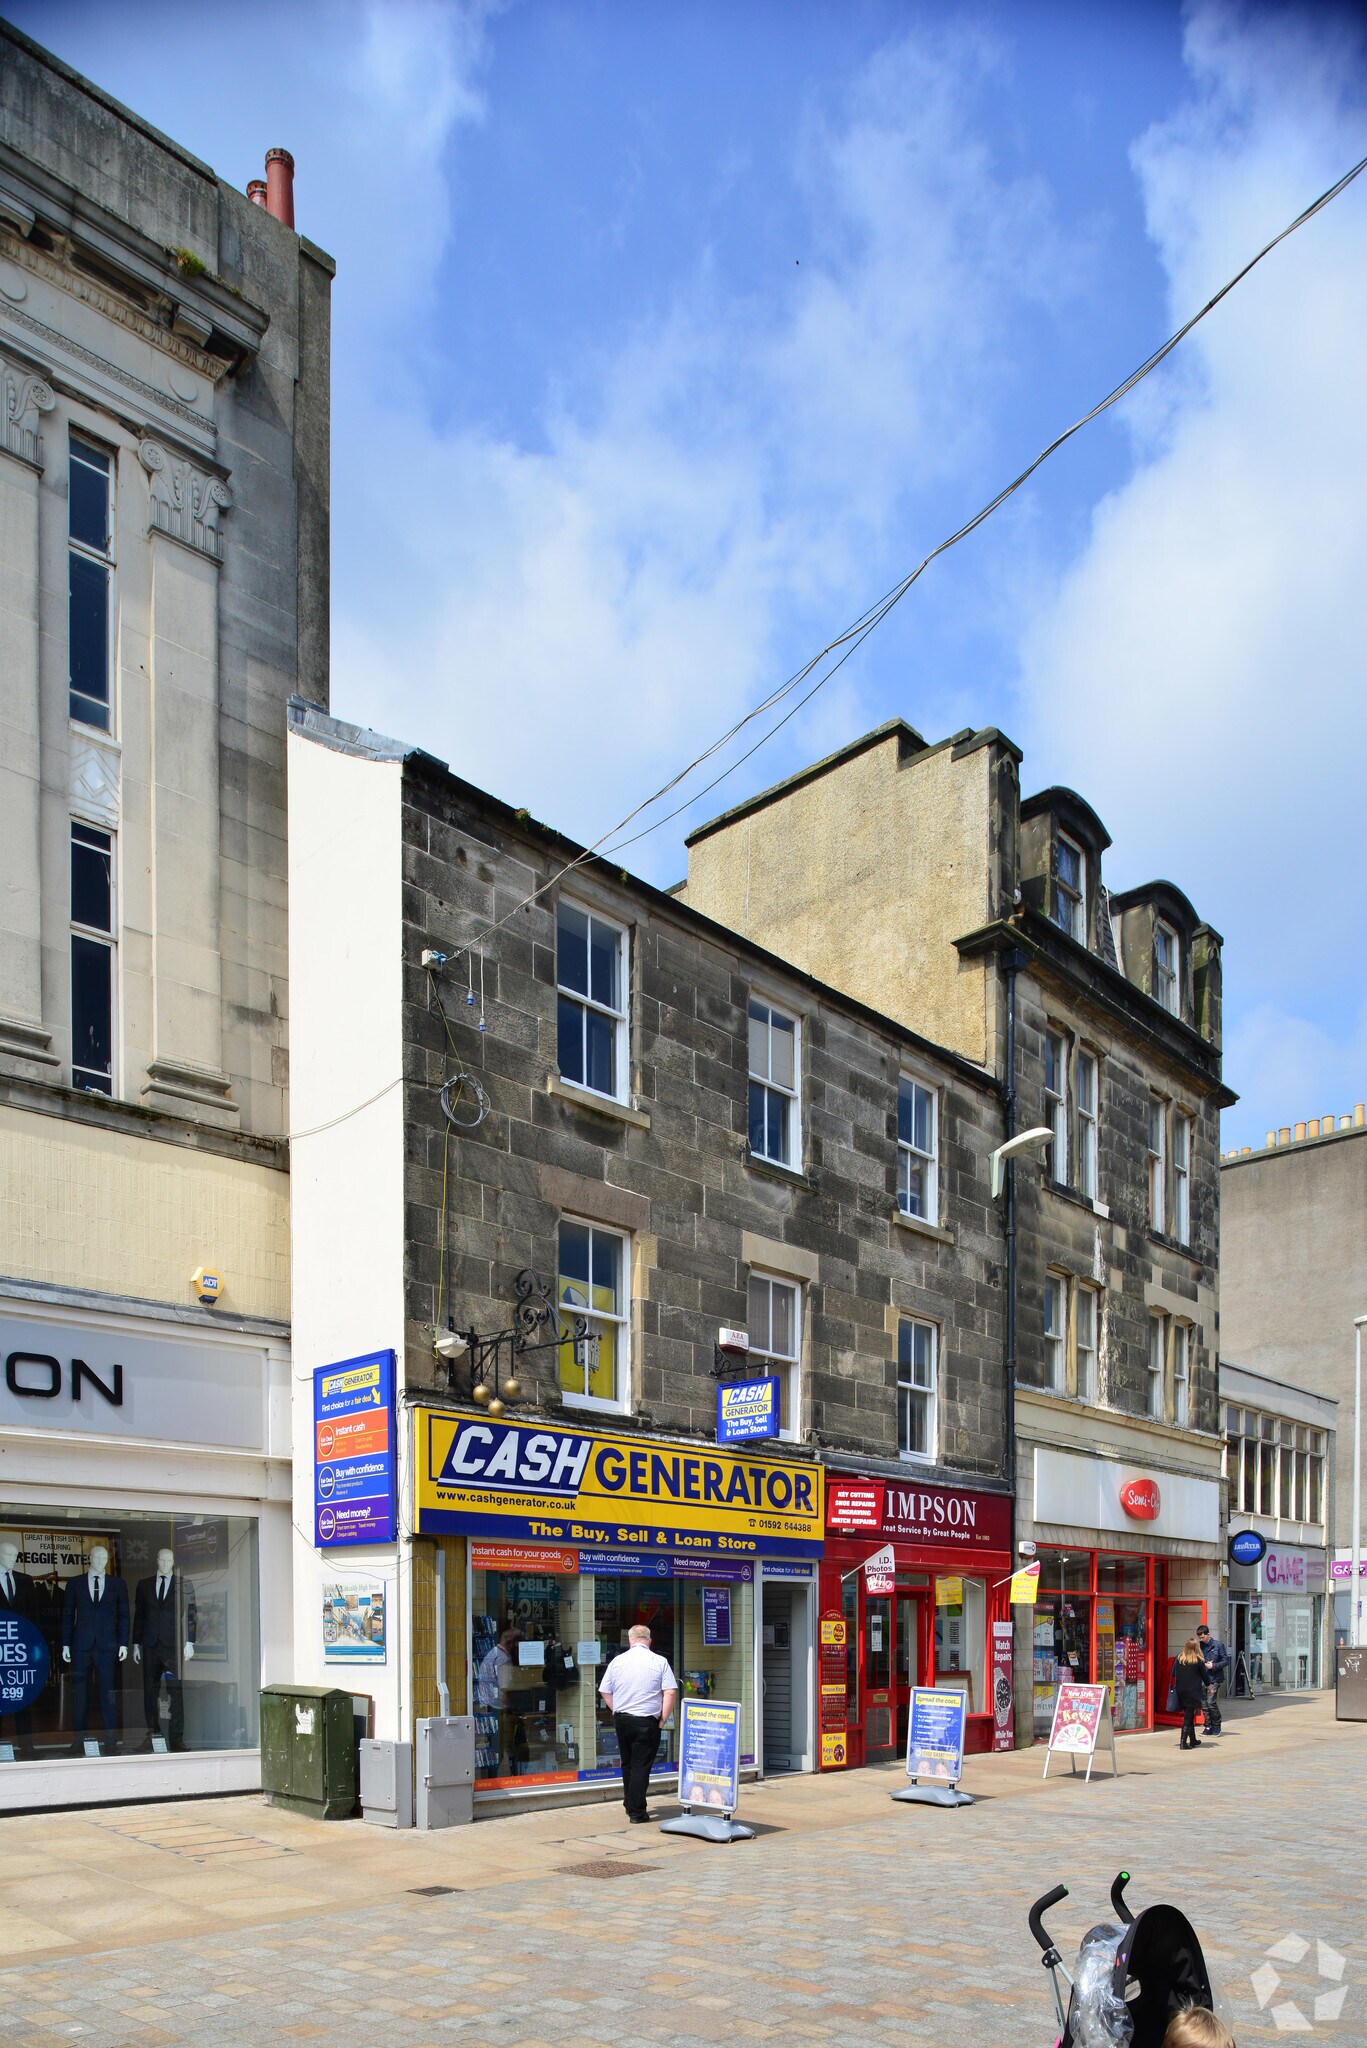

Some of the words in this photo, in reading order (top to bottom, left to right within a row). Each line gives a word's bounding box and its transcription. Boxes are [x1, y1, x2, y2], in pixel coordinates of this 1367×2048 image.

[203, 1277, 218, 1288] ADT
[328, 1377, 344, 1391] CASH
[344, 1372, 374, 1386] GENERATOR
[729, 1384, 766, 1404] CASH
[322, 1404, 331, 1412] First
[331, 1401, 344, 1410] choice
[362, 1394, 371, 1402] deal
[725, 1404, 768, 1417] GENERATOR
[727, 1419, 739, 1427] The
[740, 1418, 753, 1426] Buy,
[755, 1415, 767, 1423] Sell
[336, 1424, 353, 1436] Instant
[353, 1421, 365, 1432] cash
[750, 1425, 767, 1433] Store
[336, 1468, 345, 1478] Buy
[346, 1466, 355, 1475] with
[356, 1463, 384, 1474] confidence
[451, 1426, 591, 1486] CASH
[595, 1448, 813, 1511] GENERATOR
[436, 1491, 576, 1510] www.cashgenerator.co.uk
[337, 1509, 350, 1519] Need
[351, 1506, 371, 1518] money?
[887, 1490, 976, 1527] IMPSON
[759, 1519, 781, 1530] 01592
[784, 1522, 812, 1532] 644388
[528, 1521, 563, 1537] The
[571, 1525, 610, 1543] Buy,
[617, 1529, 648, 1542] Sell
[656, 1532, 667, 1544] &
[675, 1533, 711, 1547] Loan
[718, 1536, 757, 1550] Store
[897, 1525, 921, 1534] Service
[923, 1527, 931, 1537] By
[933, 1528, 949, 1537] Great
[951, 1530, 970, 1540] People
[40, 1543, 71, 1551] FEATURING
[472, 1546, 495, 1556] Instant
[496, 1548, 512, 1556] cash
[513, 1548, 523, 1557] for
[524, 1551, 539, 1559] your
[540, 1551, 561, 1560] goods
[16, 1552, 57, 1565] REGGIE
[579, 1552, 591, 1562] Buy
[592, 1553, 606, 1561] with
[607, 1554, 640, 1563] confidence
[674, 1558, 688, 1566] Need
[689, 1560, 710, 1568] money?
[867, 1565, 892, 1573] Photos
[1266, 1554, 1303, 1585] GAME
[1334, 1565, 1366, 1574] GAE
[995, 1640, 1010, 1650] Watch
[0, 1643, 27, 1663] ES
[994, 1651, 1012, 1663] Repairs
[7, 1669, 37, 1685] SUIT
[917, 1696, 935, 1704] Spread
[1071, 1700, 1095, 1712] Fun
[688, 1709, 707, 1718] Spread
[1062, 1710, 1092, 1723] Keys
[1000, 1740, 1009, 1748] Wait
[823, 1747, 833, 1756] Keys
